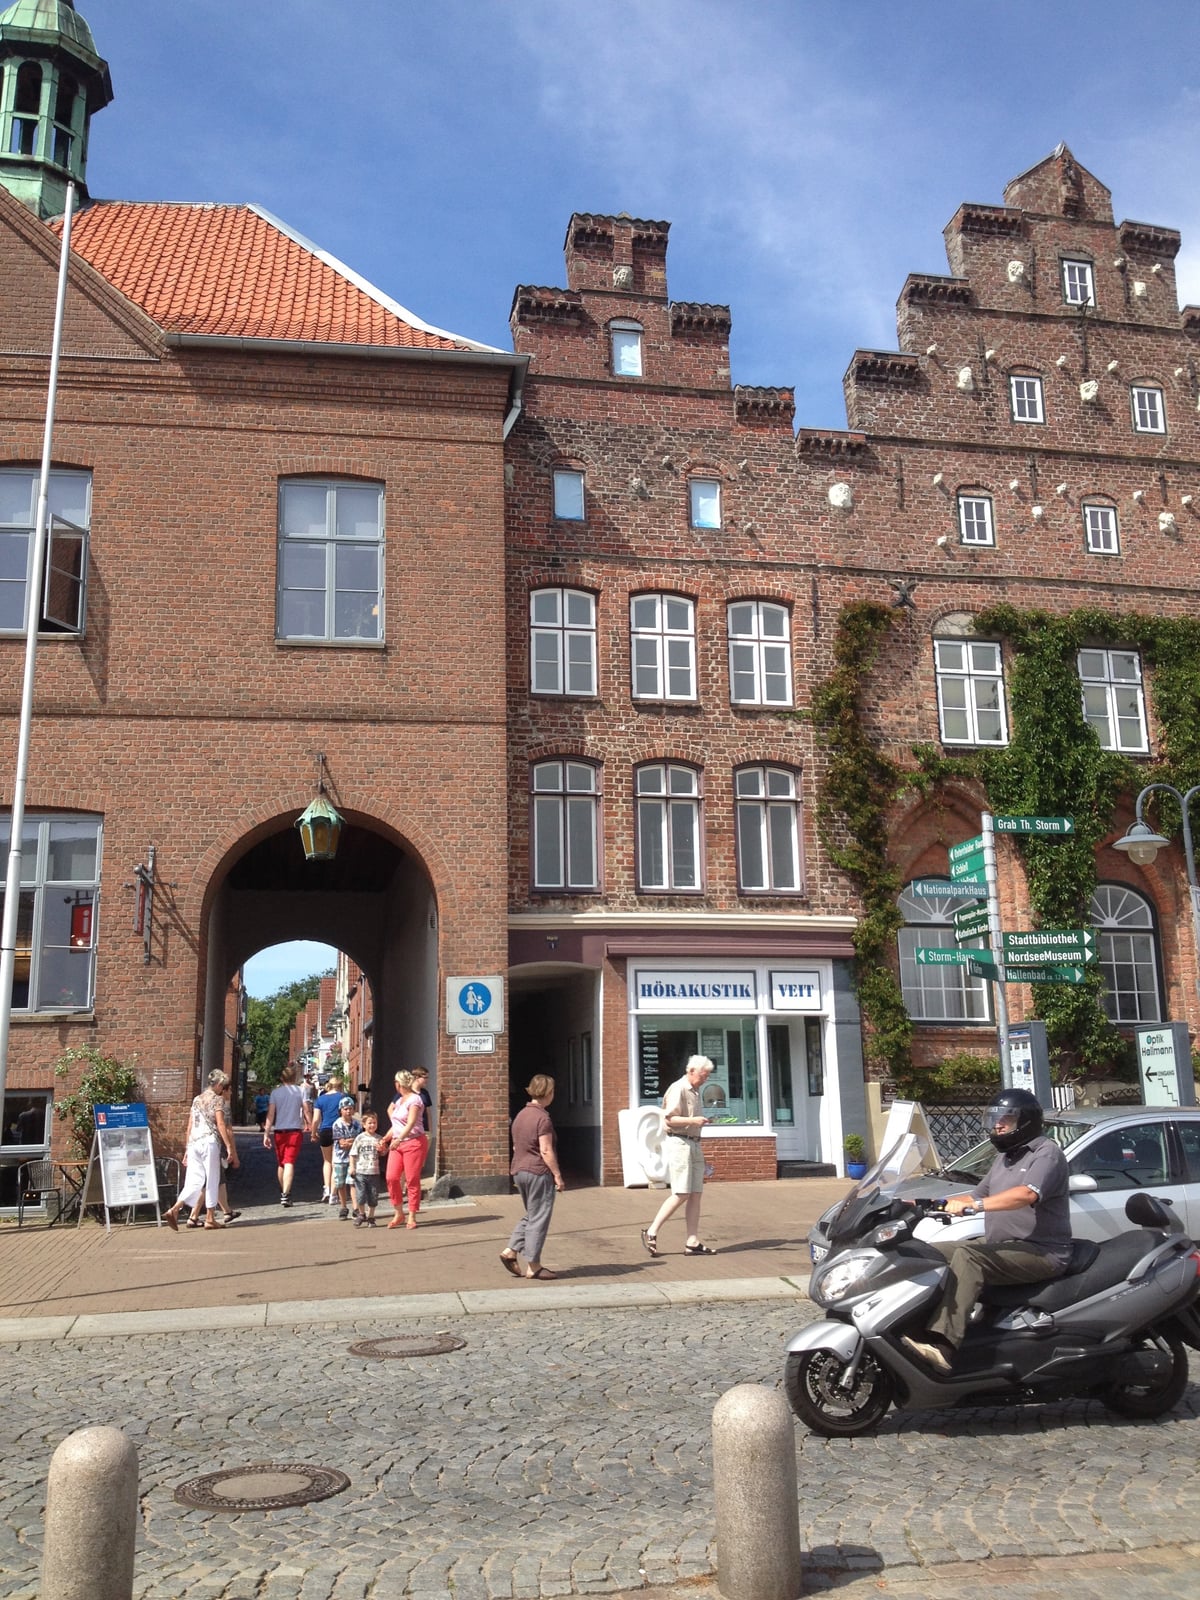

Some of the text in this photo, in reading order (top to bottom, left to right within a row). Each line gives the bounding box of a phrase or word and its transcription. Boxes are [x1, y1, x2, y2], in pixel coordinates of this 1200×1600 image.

[997, 818, 1060, 831] Grab Th. Storm
[923, 884, 987, 897] NationalparkHaus
[1008, 932, 1079, 946] Stadtbibliothek
[928, 950, 975, 962] Storm-Haus
[1008, 950, 1082, 963] NordseeMuseum
[1006, 969, 1046, 980] Hallenbad
[640, 981, 752, 998] HÖRAKUSTIK
[778, 984, 815, 998] VEIT
[461, 1018, 489, 1029] ZONE
[461, 1037, 489, 1045] Anlieger
[1146, 1033, 1164, 1046] Optik
[1142, 1045, 1174, 1057] Hallmann
